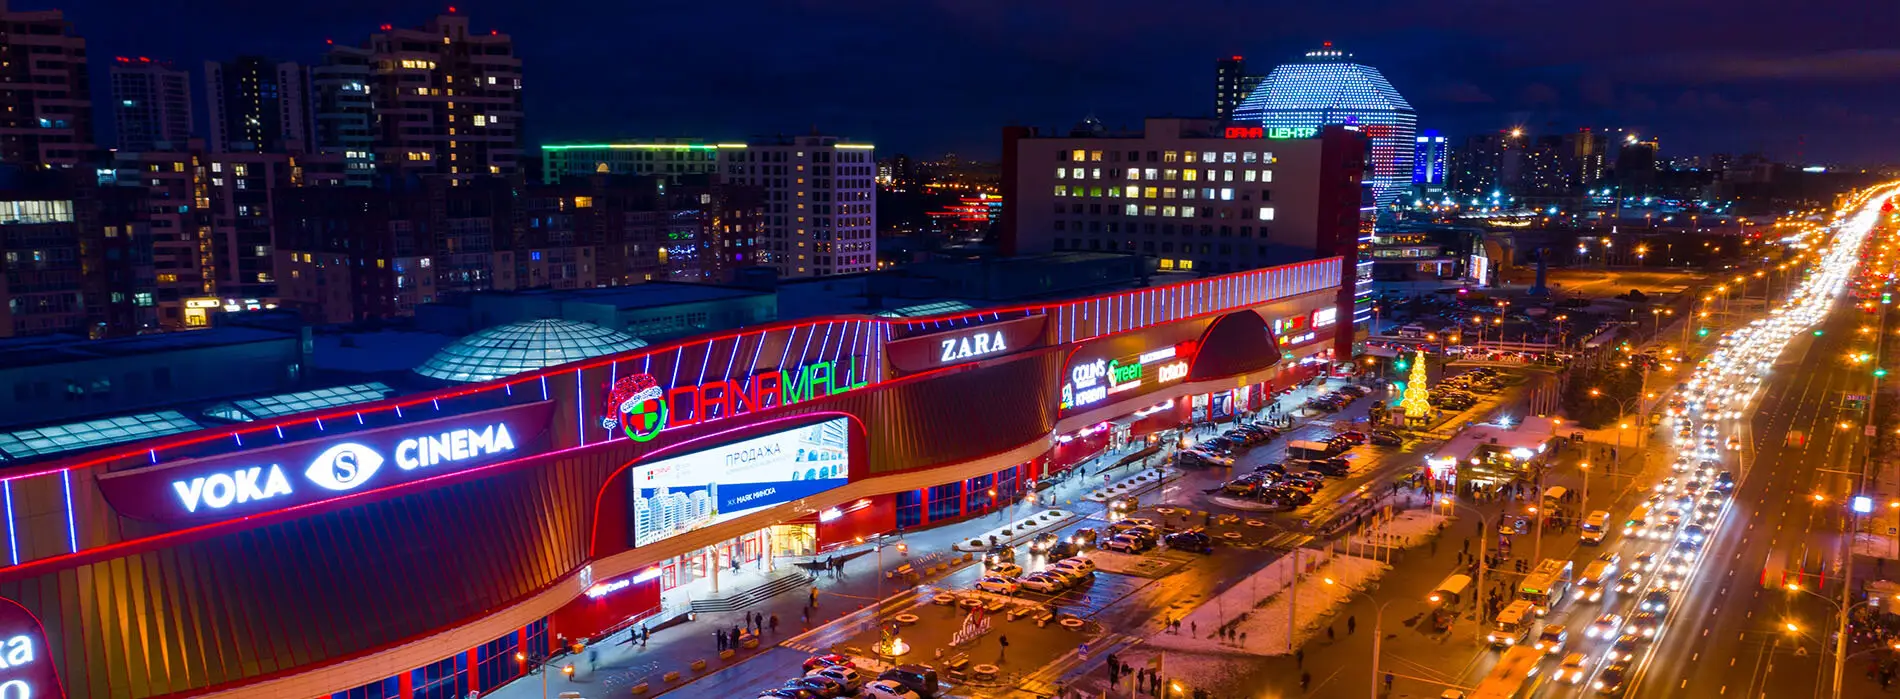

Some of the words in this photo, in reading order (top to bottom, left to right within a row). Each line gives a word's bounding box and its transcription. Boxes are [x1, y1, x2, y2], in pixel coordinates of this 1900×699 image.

[941, 330, 1007, 362] ZARA
[172, 463, 293, 513] VOKA
[395, 422, 515, 471] CINEMA
[725, 442, 781, 467] ПРОДАЖА
